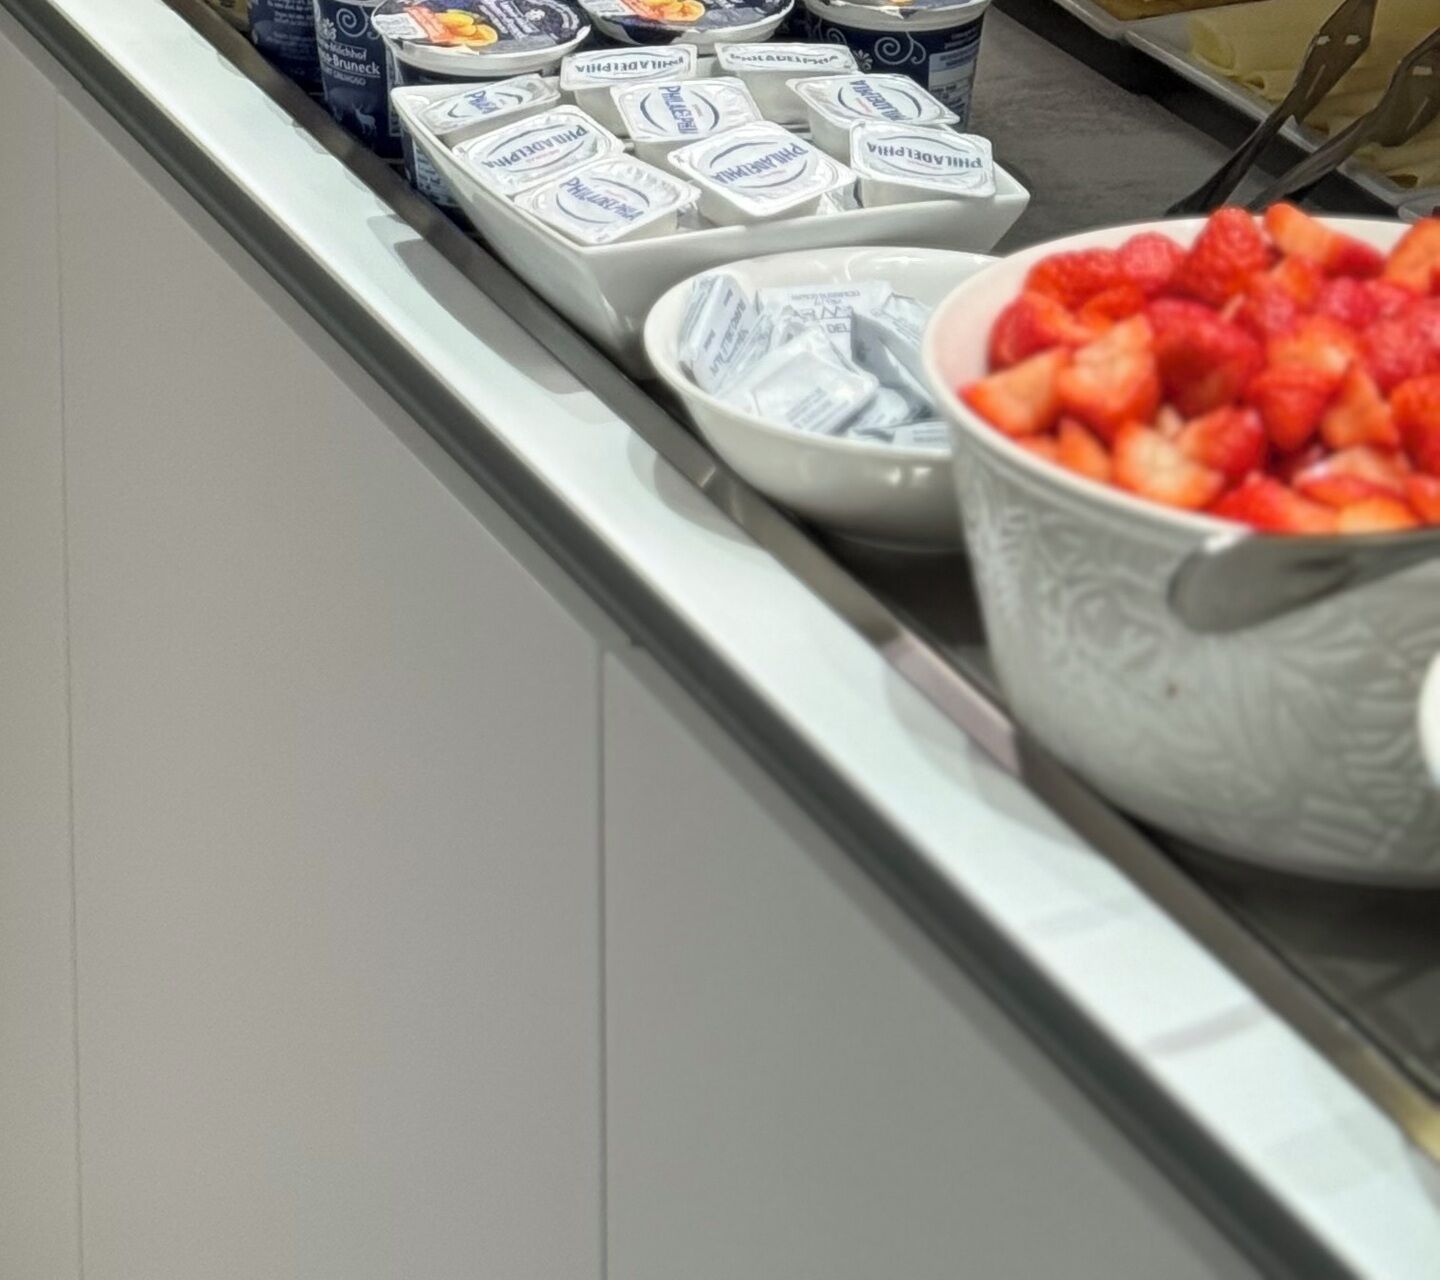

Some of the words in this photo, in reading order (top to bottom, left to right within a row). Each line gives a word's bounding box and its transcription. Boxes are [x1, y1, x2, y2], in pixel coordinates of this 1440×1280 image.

[481, 125, 589, 169] PHILADELPHIA
[710, 142, 809, 185] PHILADELPHIA
[866, 141, 984, 169] PHILADELPHIA
